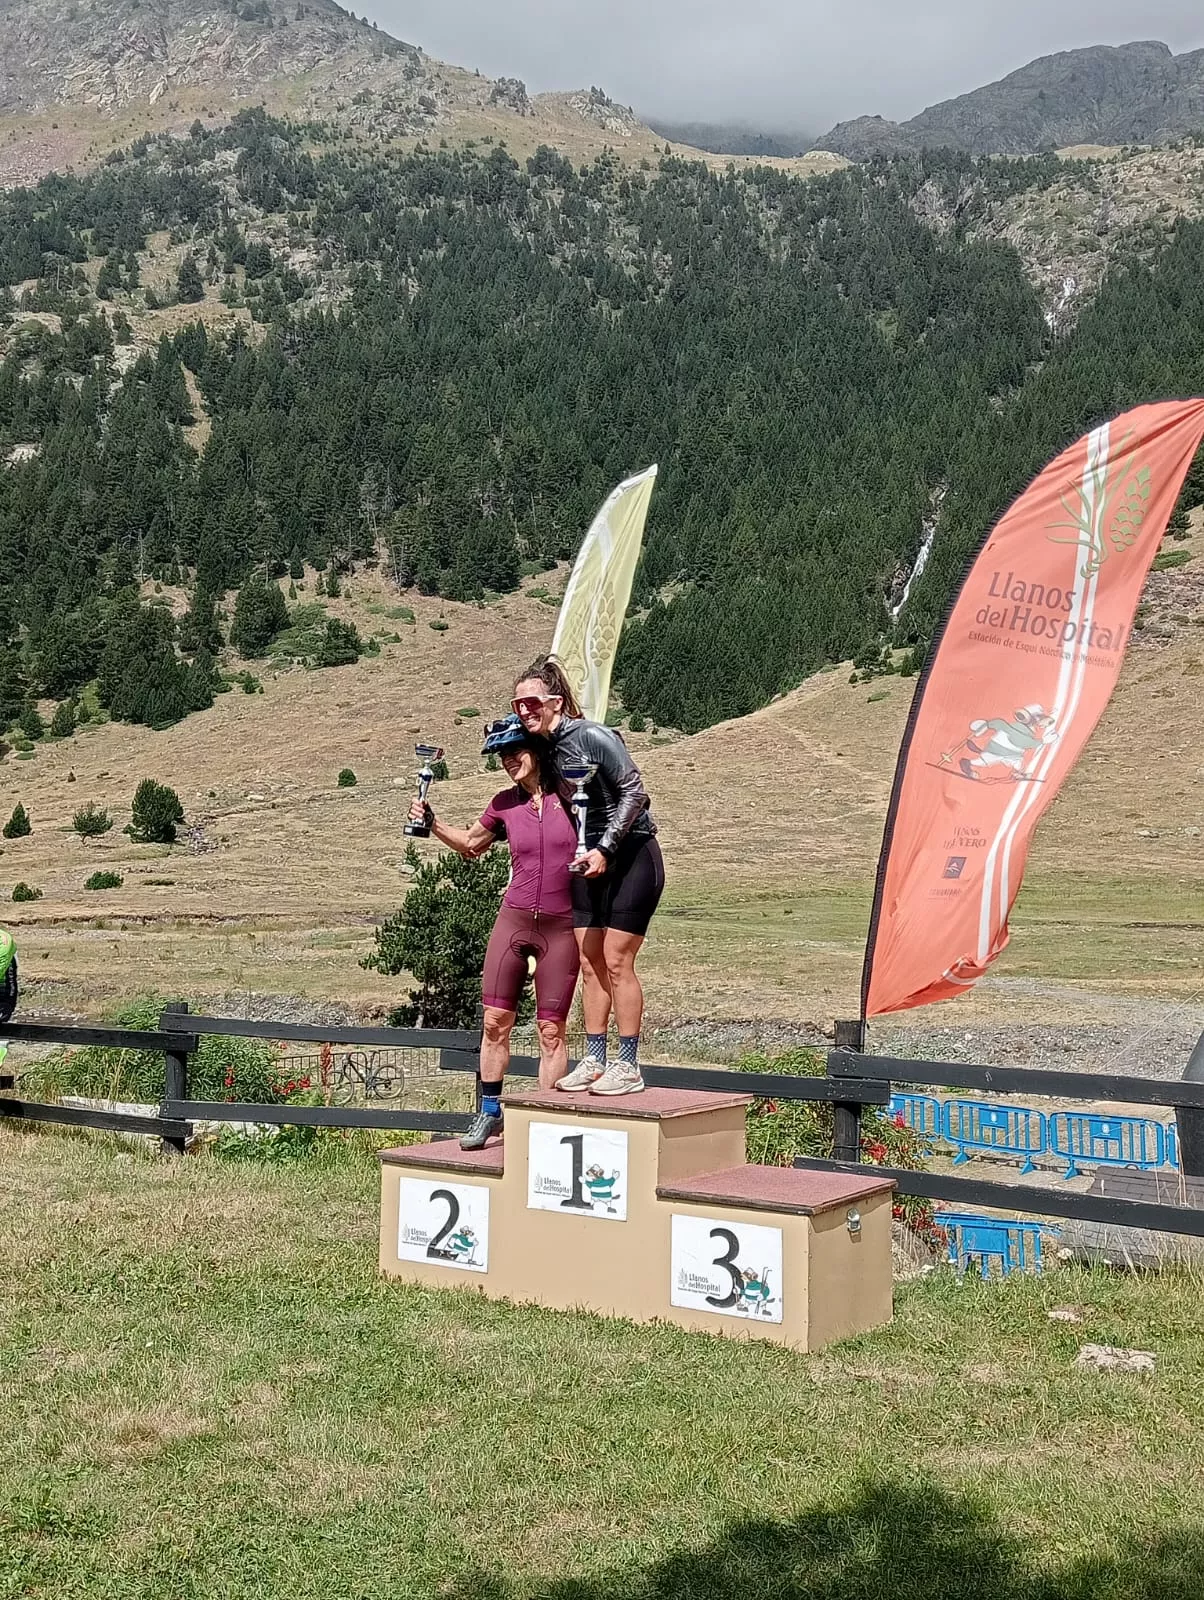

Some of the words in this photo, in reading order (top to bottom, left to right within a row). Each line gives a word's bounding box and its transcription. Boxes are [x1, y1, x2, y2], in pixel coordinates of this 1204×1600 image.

[988, 571, 1076, 612] Llanos
[1003, 637, 1015, 648] de
[1009, 605, 1124, 651] Hospital
[560, 1133, 594, 1210] 1
[426, 1189, 460, 1261] 2
[705, 1227, 744, 1308] 3
